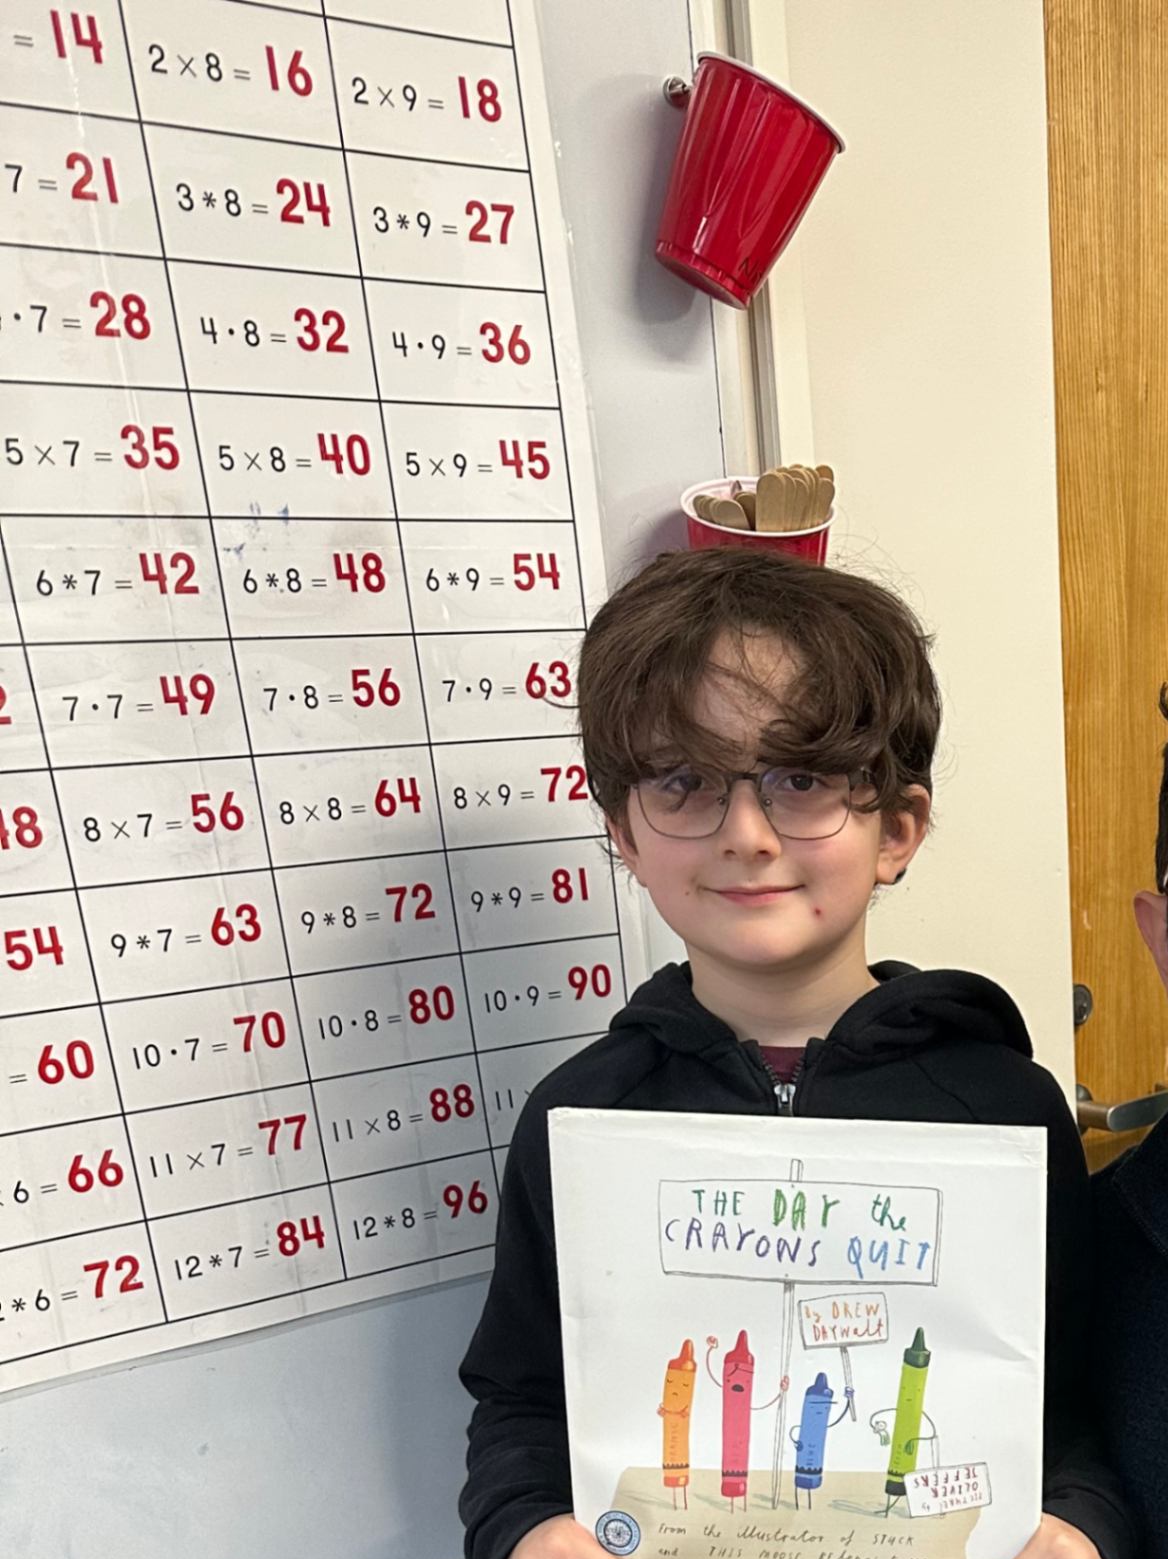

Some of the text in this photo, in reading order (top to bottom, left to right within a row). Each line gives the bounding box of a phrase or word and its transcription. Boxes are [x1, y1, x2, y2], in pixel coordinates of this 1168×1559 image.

[50, 9, 103, 65] 14
[148, 44, 313, 97] 2 8 16
[352, 76, 502, 123] 2 9 18
[5, 152, 118, 204] 7 21
[176, 178, 331, 227] 3 8 24
[373, 200, 515, 244] 3 9 27
[30, 290, 151, 341] 7 28
[200, 307, 349, 354] 4 8 32
[392, 321, 531, 366] 4 9 36
[5, 424, 180, 471] 5 7 35
[219, 433, 371, 476] 5 8 40
[406, 440, 551, 481] 5 9 45
[36, 551, 199, 596] 6 7 42
[243, 551, 386, 594] 6 8 48
[426, 552, 560, 592] 6 9 54
[62, 673, 216, 721] 7 7 49
[263, 668, 401, 711] 7 8 56
[442, 660, 572, 702] 7 9 63
[279, 778, 421, 825] 8 8 64
[454, 764, 589, 809] 8 9 72
[83, 791, 245, 842] 8 7 56
[301, 883, 435, 934] 9 8 72
[471, 868, 589, 912] 9 9 81
[4, 926, 64, 971] 54
[111, 903, 262, 958] 9 7 63
[319, 985, 455, 1039] 10 8 80
[485, 964, 611, 1013] 10 9 90
[37, 1039, 95, 1085] 60
[133, 1011, 286, 1070] 10 7 70
[333, 1084, 473, 1142] 11 8 88
[496, 1089, 513, 1110] 11
[150, 1113, 307, 1178] 11 7 77
[13, 1149, 124, 1204] 6 66
[354, 1182, 489, 1240] 12 8 96
[692, 1188, 907, 1232] THE DAY the
[175, 1216, 325, 1280] 12 7 84
[665, 1217, 931, 1279] CRAYONS QUIT
[35, 1254, 144, 1311] 6 72
[832, 1301, 880, 1319] DREW
[703, 1524, 721, 1538] the
[840, 1529, 855, 1547] of
